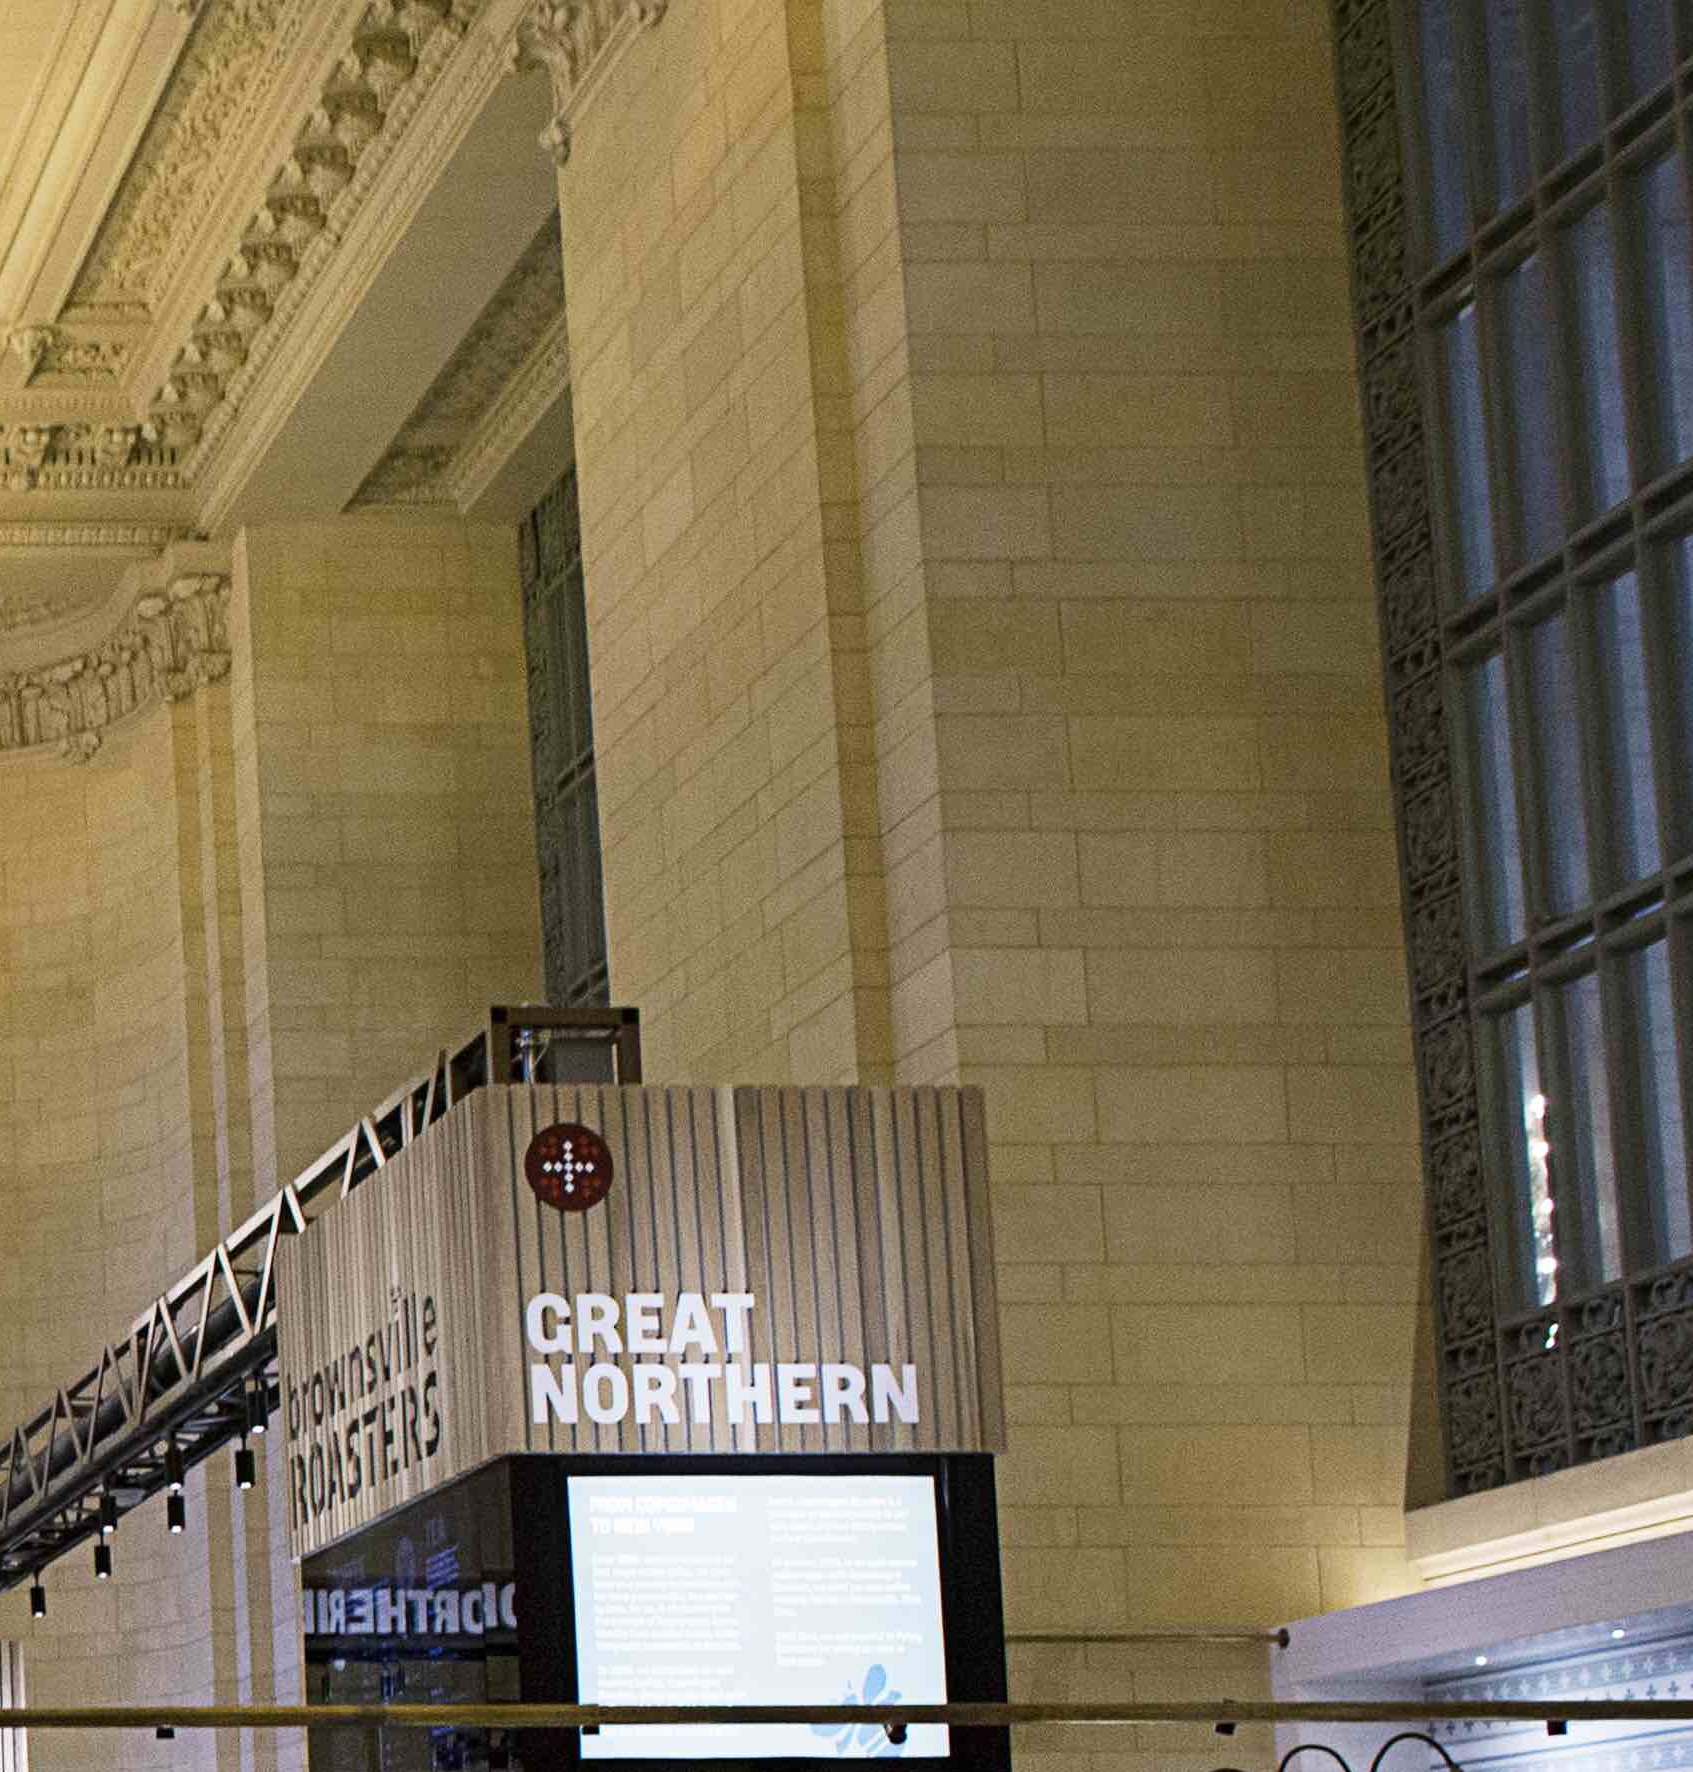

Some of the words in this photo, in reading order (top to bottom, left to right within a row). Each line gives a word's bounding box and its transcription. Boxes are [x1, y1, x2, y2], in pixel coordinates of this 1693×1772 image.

[525, 1292, 755, 1354] GREAT
[533, 1363, 919, 1424] NORTHERN
[290, 1370, 441, 1532] ROASTERS
